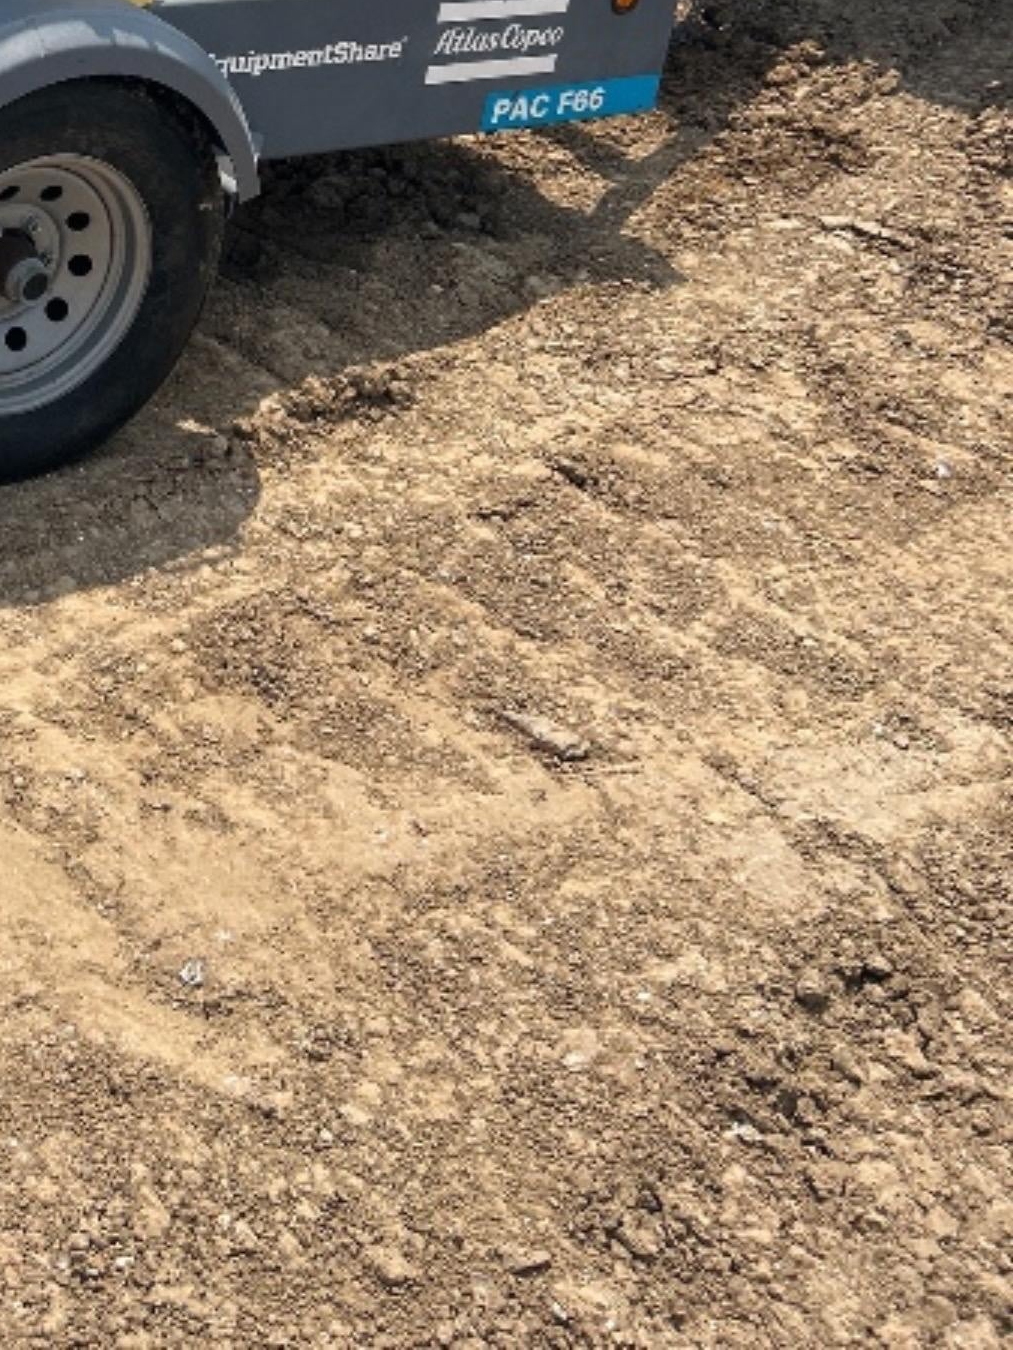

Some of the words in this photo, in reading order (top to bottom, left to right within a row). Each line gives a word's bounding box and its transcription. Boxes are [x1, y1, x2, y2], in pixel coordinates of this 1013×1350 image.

[209, 41, 402, 78] quipmentShare
[491, 94, 550, 124] PAC
[557, 86, 606, 115] F66
